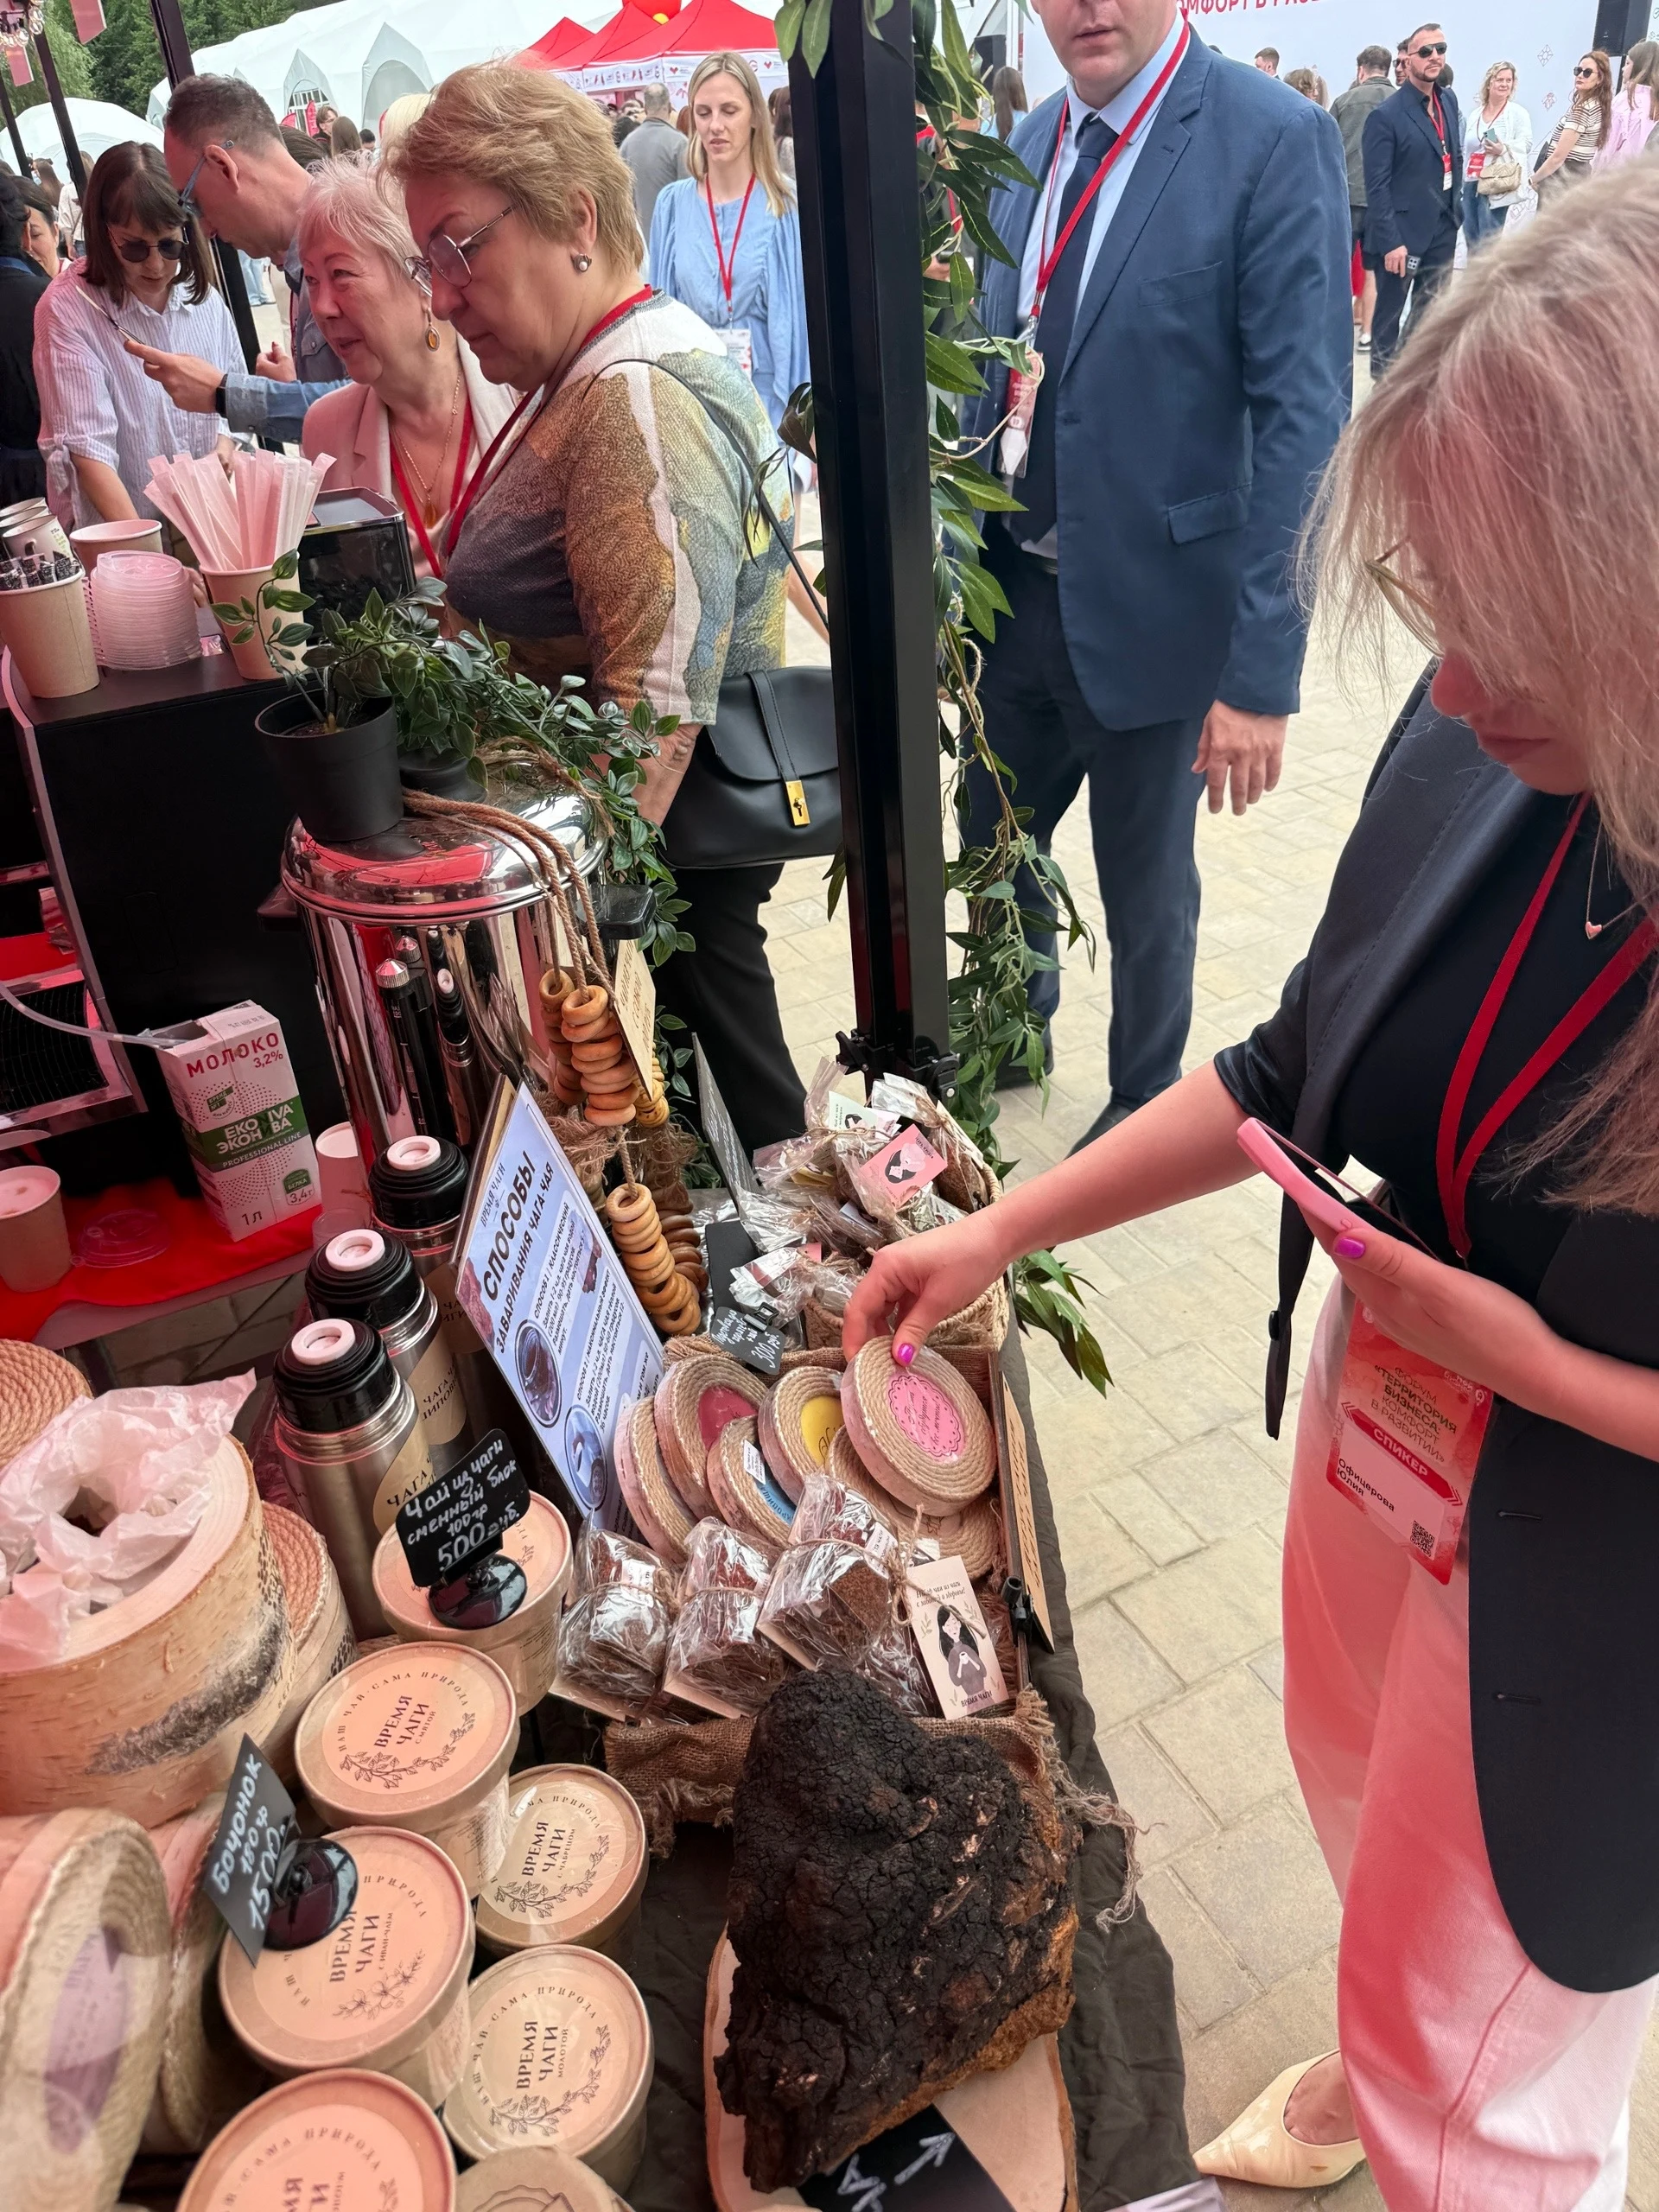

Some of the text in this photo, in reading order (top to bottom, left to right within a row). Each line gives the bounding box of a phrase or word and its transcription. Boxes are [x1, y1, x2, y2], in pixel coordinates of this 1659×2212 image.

[187, 1033, 279, 1077] МОЛОКО
[254, 1051, 283, 1068] 3,2%
[222, 1141, 283, 1167] PROFESSIONAL
[283, 1132, 302, 1147] LINE
[288, 1178, 308, 1190] БЕЛКА
[480, 1162, 505, 1226] ВРЕМЯ ЧАГИ
[484, 1150, 535, 1300] СПОСОБЫ
[496, 1162, 553, 1352] ЗАВАРИВАНИЯ ЧАГА-ЧАЯ
[534, 1279, 547, 1319] СПОСОБ
[548, 1202, 569, 1268] КЛАССИЧЕСКИЙ
[570, 1242, 582, 1281] настояться
[543, 1300, 552, 1328] Залить
[576, 1367, 586, 1400] СПОСОБ
[586, 1295, 603, 1357] МАКСИМАЛЬНЫЙ
[751, 1342, 775, 1368] 300
[423, 1376, 448, 1403] ЧАГА
[585, 1376, 594, 1407] Залить
[1374, 1363, 1457, 1433] «ТЕРРИТОРИЯ
[1384, 1384, 1440, 1434] БИЗНЕСА:
[1395, 1366, 1438, 1403] ФОРУМ
[1371, 1398, 1445, 1463] В РАЗВИТИИ»
[1382, 1395, 1440, 1444] КОМФОРТ
[1373, 1428, 1428, 1478] СПИКЕР
[387, 1469, 428, 1507] ЧАГА
[405, 1439, 503, 1517] Чай из чаги
[408, 1459, 517, 1546] сменный блок
[1337, 1466, 1364, 1497] Юлия
[1338, 1458, 1395, 1512] Офицерова
[438, 1522, 487, 1571] 500
[338, 1671, 468, 1751] НАШ ЧАЙ САМА ПРИРОДА
[374, 1695, 413, 1747] ВРЕМЯ
[961, 1690, 992, 1707] ВРЕМЯ ЧАГИ
[396, 1703, 429, 1745] ЧАГИ
[420, 1710, 436, 1738] МЯТОЙ
[212, 1753, 262, 1894] БОЧОНОК
[553, 1796, 600, 1828] ПРИРОДА
[522, 1821, 549, 1877] ВРЕМЯ
[542, 1828, 566, 1872] ЧАГИ
[560, 1828, 575, 1872] ЧАБРЕЦОМ
[285, 1875, 427, 2006] НАШ ПРИРОДА
[355, 1915, 380, 1974] ЧАГИ
[473, 2031, 488, 2062] ЧАЙ
[491, 1993, 528, 2022] САМА
[537, 1986, 596, 2018] ПРИРОДА
[516, 2020, 538, 2089] ВРЕМЯ
[538, 2026, 558, 2082] ЧАГИ
[558, 2029, 569, 2078] МОЛОТОЙ
[305, 2126, 381, 2171] ПРИРОДА
